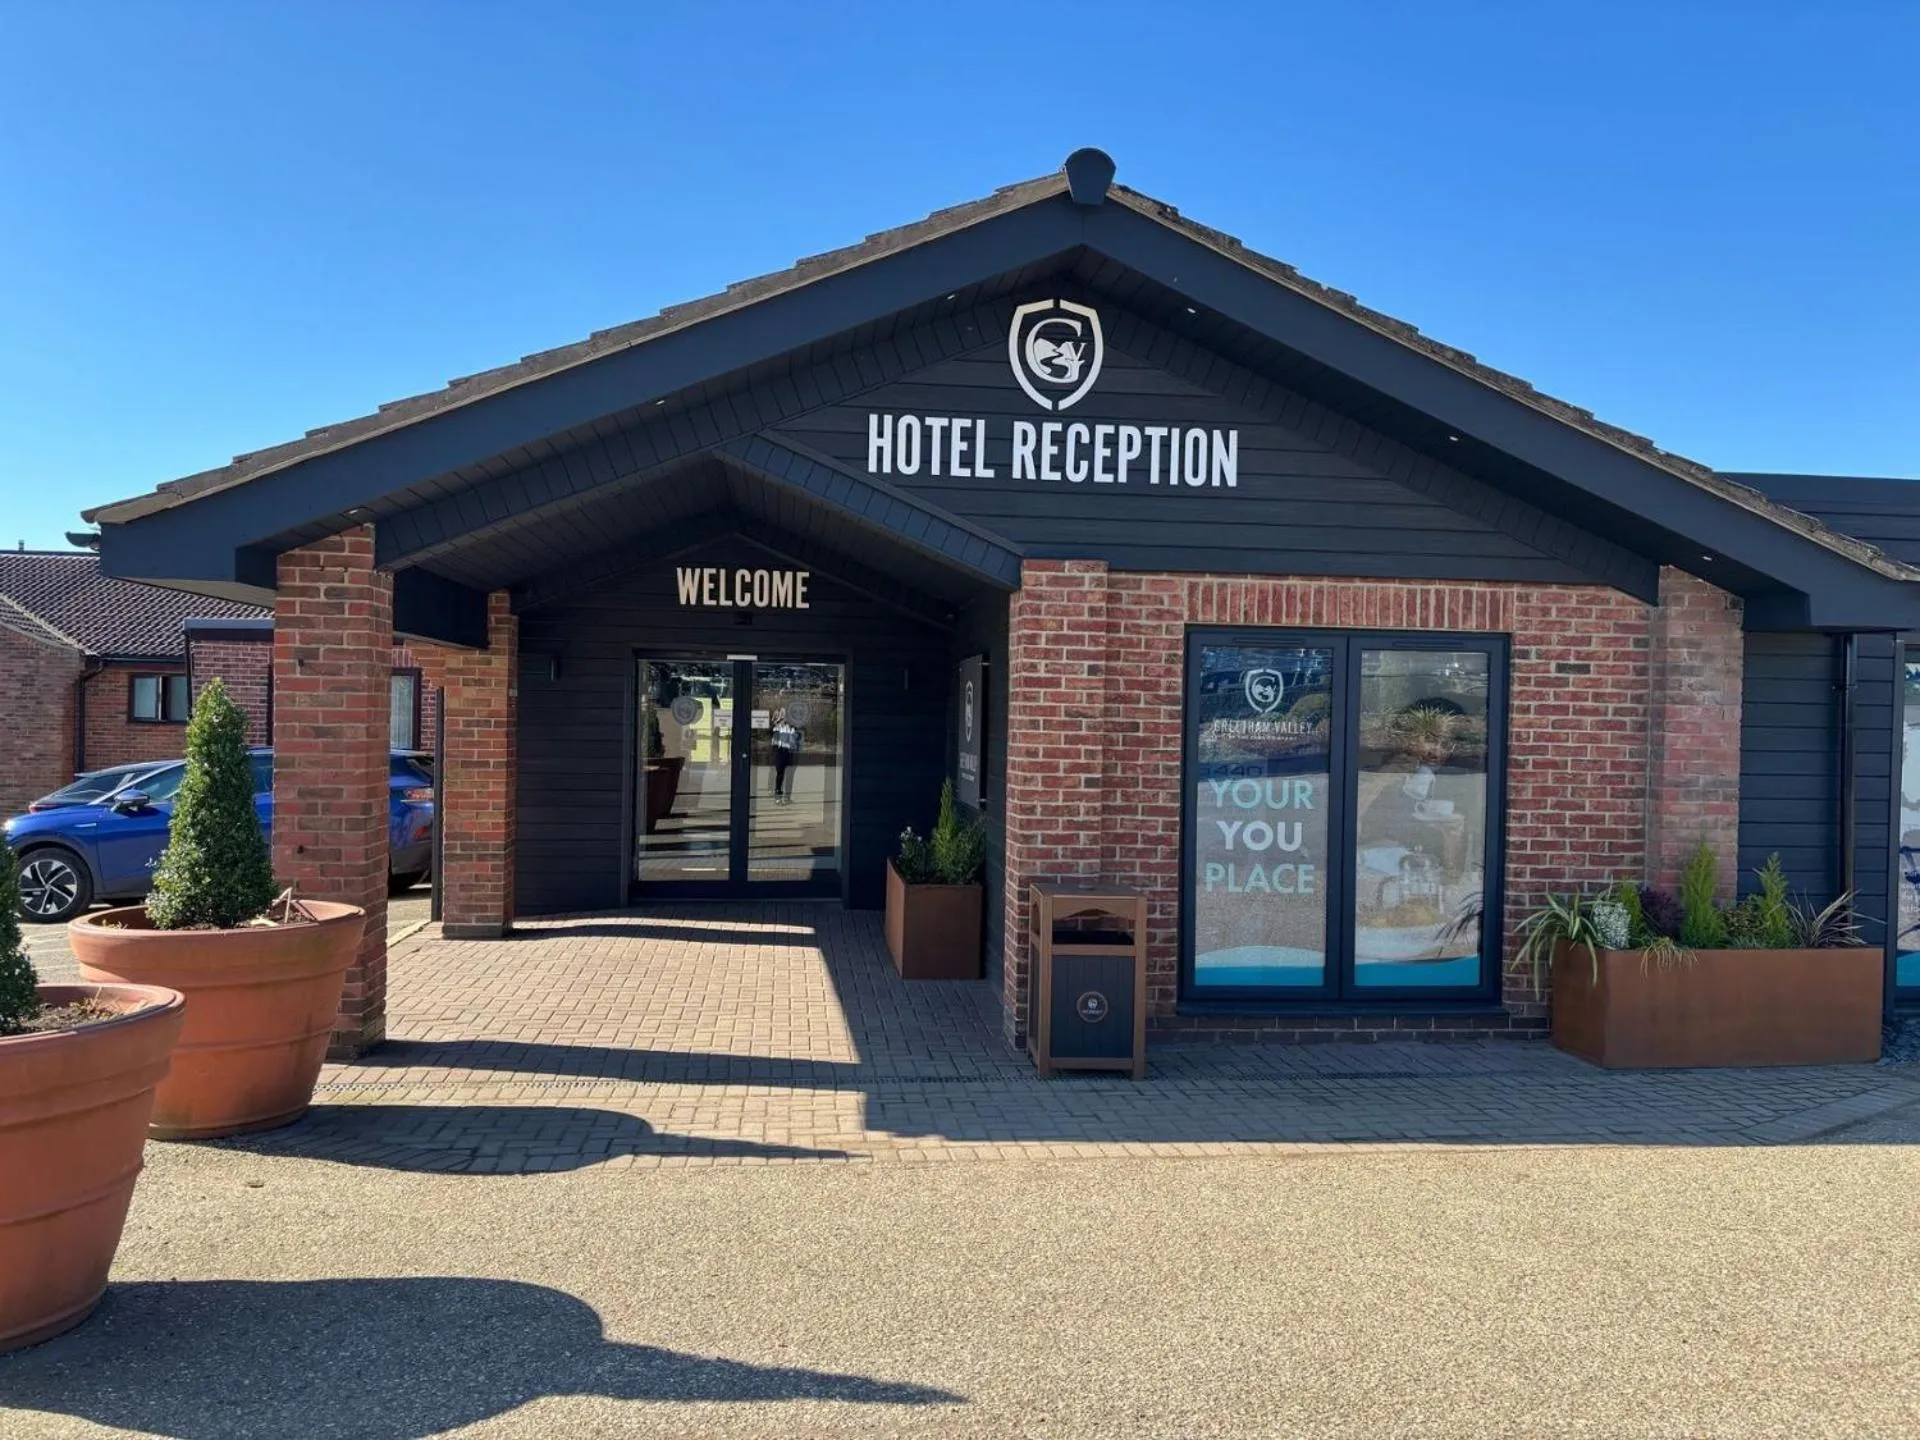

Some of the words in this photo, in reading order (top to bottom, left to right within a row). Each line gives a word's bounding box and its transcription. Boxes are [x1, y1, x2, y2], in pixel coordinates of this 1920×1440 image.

[868, 413, 995, 478] HOTEL
[1012, 421, 1238, 487] RECEPTION
[676, 567, 810, 609] WELCOME
[1209, 779, 1314, 810] YOUR
[1216, 820, 1303, 851] YOU
[1204, 863, 1314, 895] PLACE
